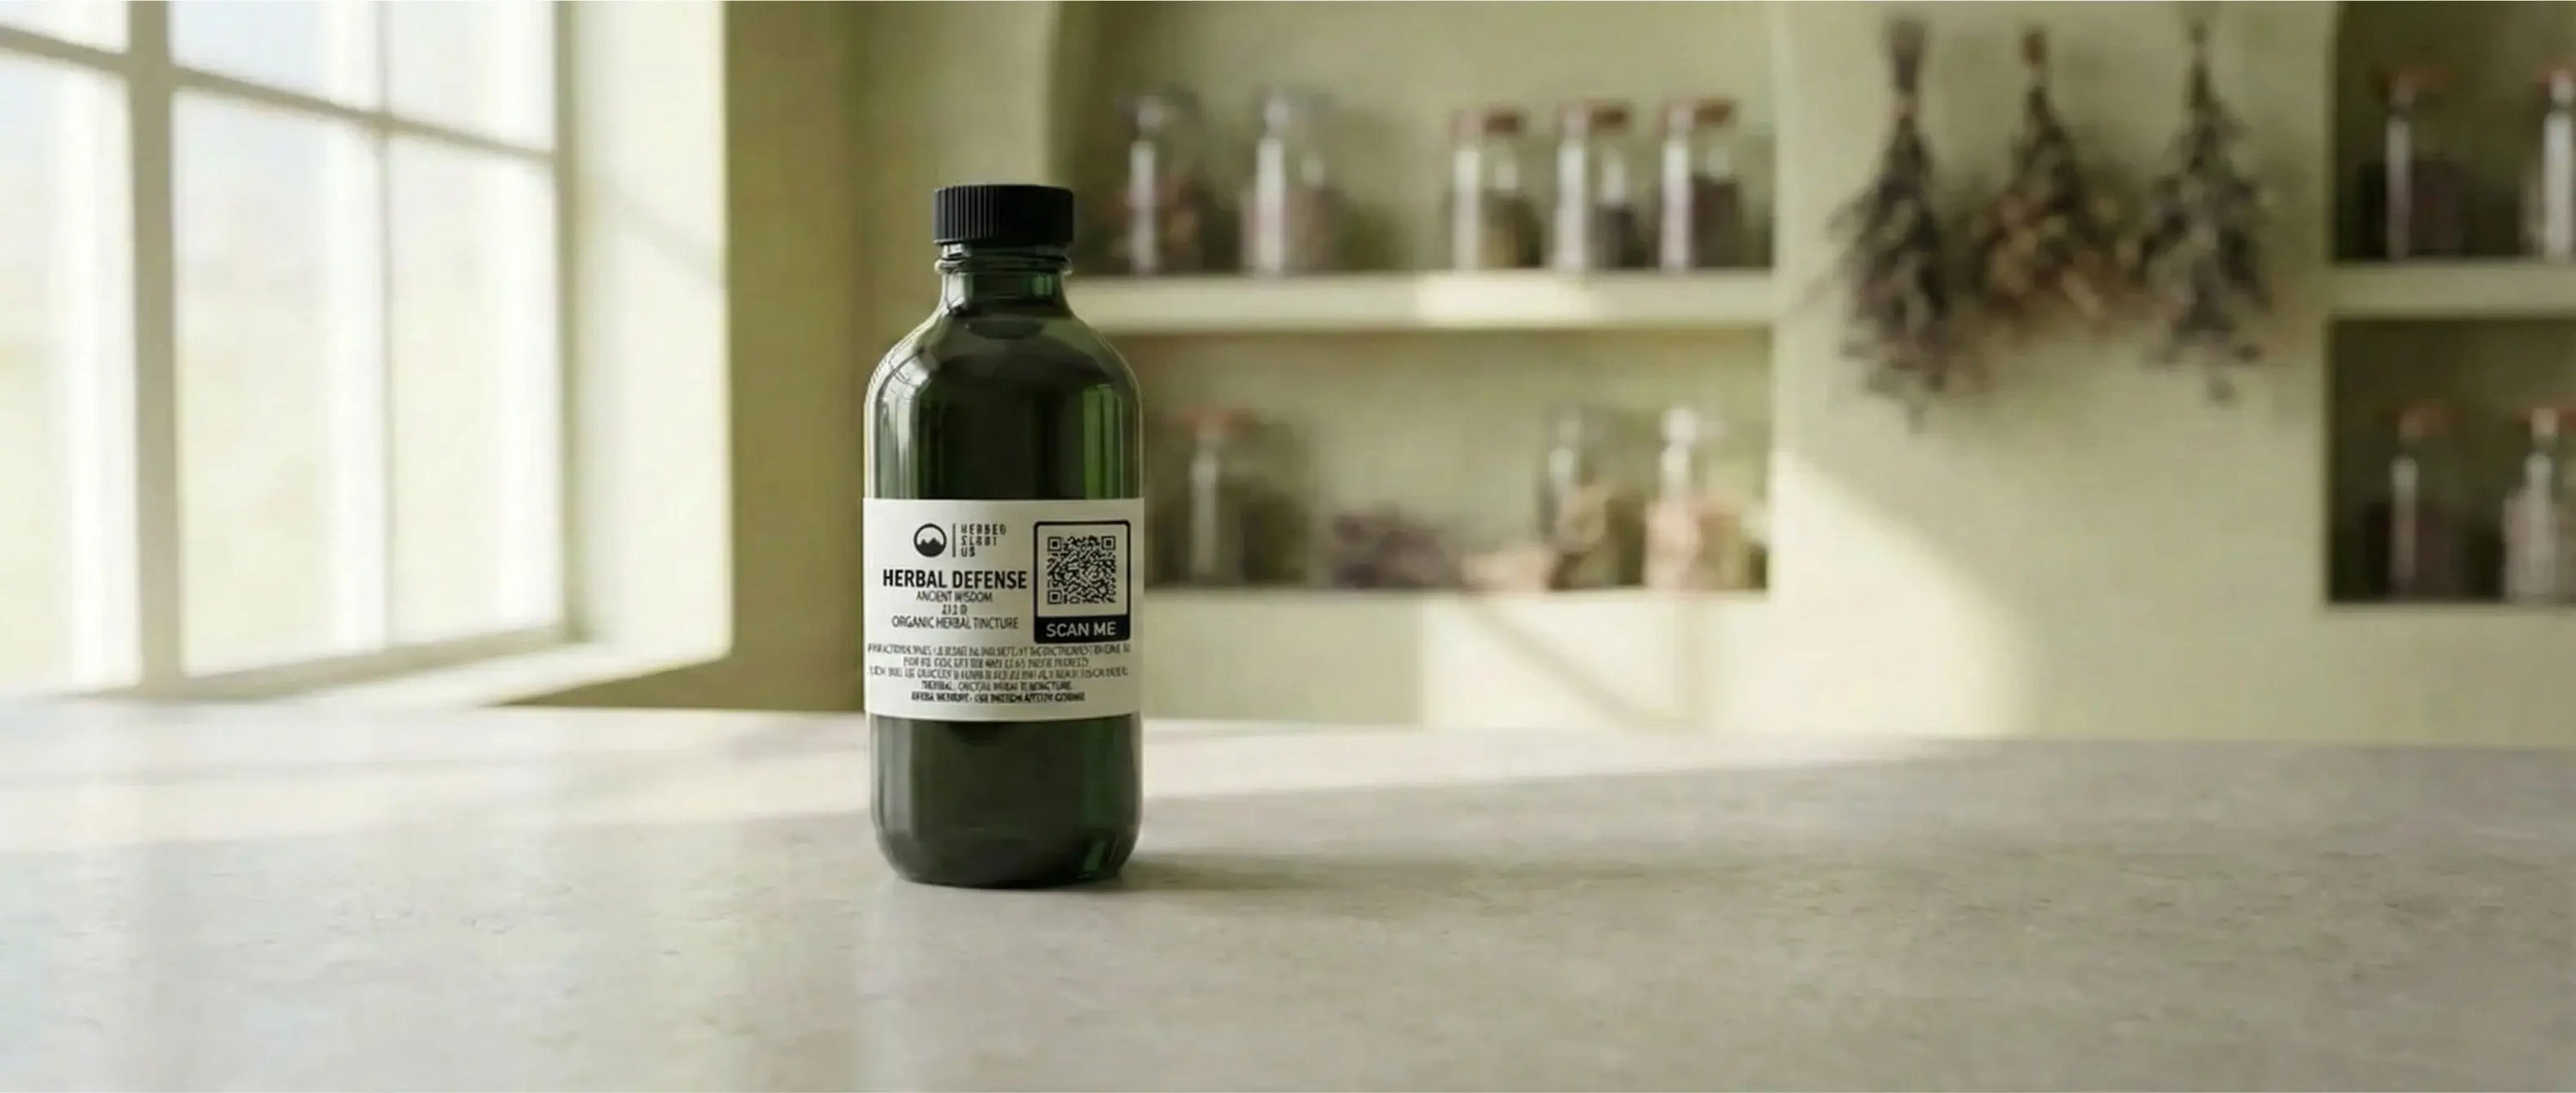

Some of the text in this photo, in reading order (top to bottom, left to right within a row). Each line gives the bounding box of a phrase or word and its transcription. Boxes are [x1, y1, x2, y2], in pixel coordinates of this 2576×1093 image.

[883, 568, 1027, 590] HERBAL DEFENSE
[891, 615, 1019, 630] ORGANIC HERBAL TINCTURE
[1045, 621, 1117, 638] SCAN ME
